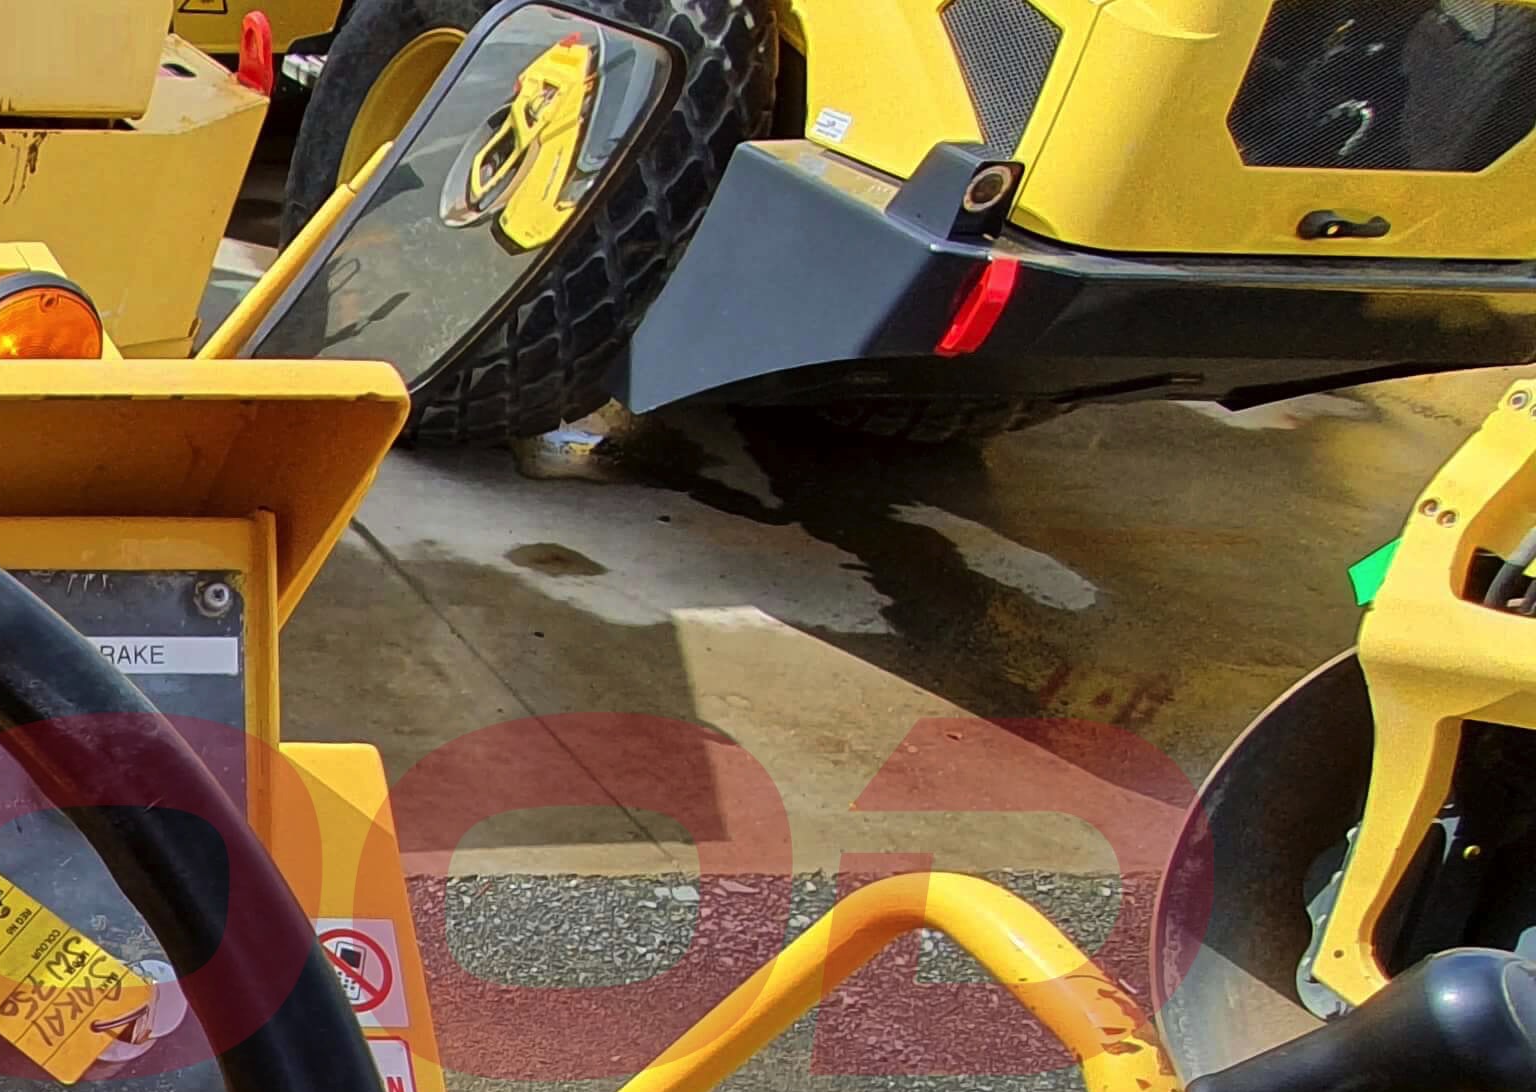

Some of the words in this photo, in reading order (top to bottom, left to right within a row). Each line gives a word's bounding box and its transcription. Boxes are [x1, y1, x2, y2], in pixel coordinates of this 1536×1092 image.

[99, 644, 165, 665] RAKE
[14, 906, 32, 926] REG
[30, 927, 61, 962] COLOUR
[34, 955, 122, 1046] SAKAI
